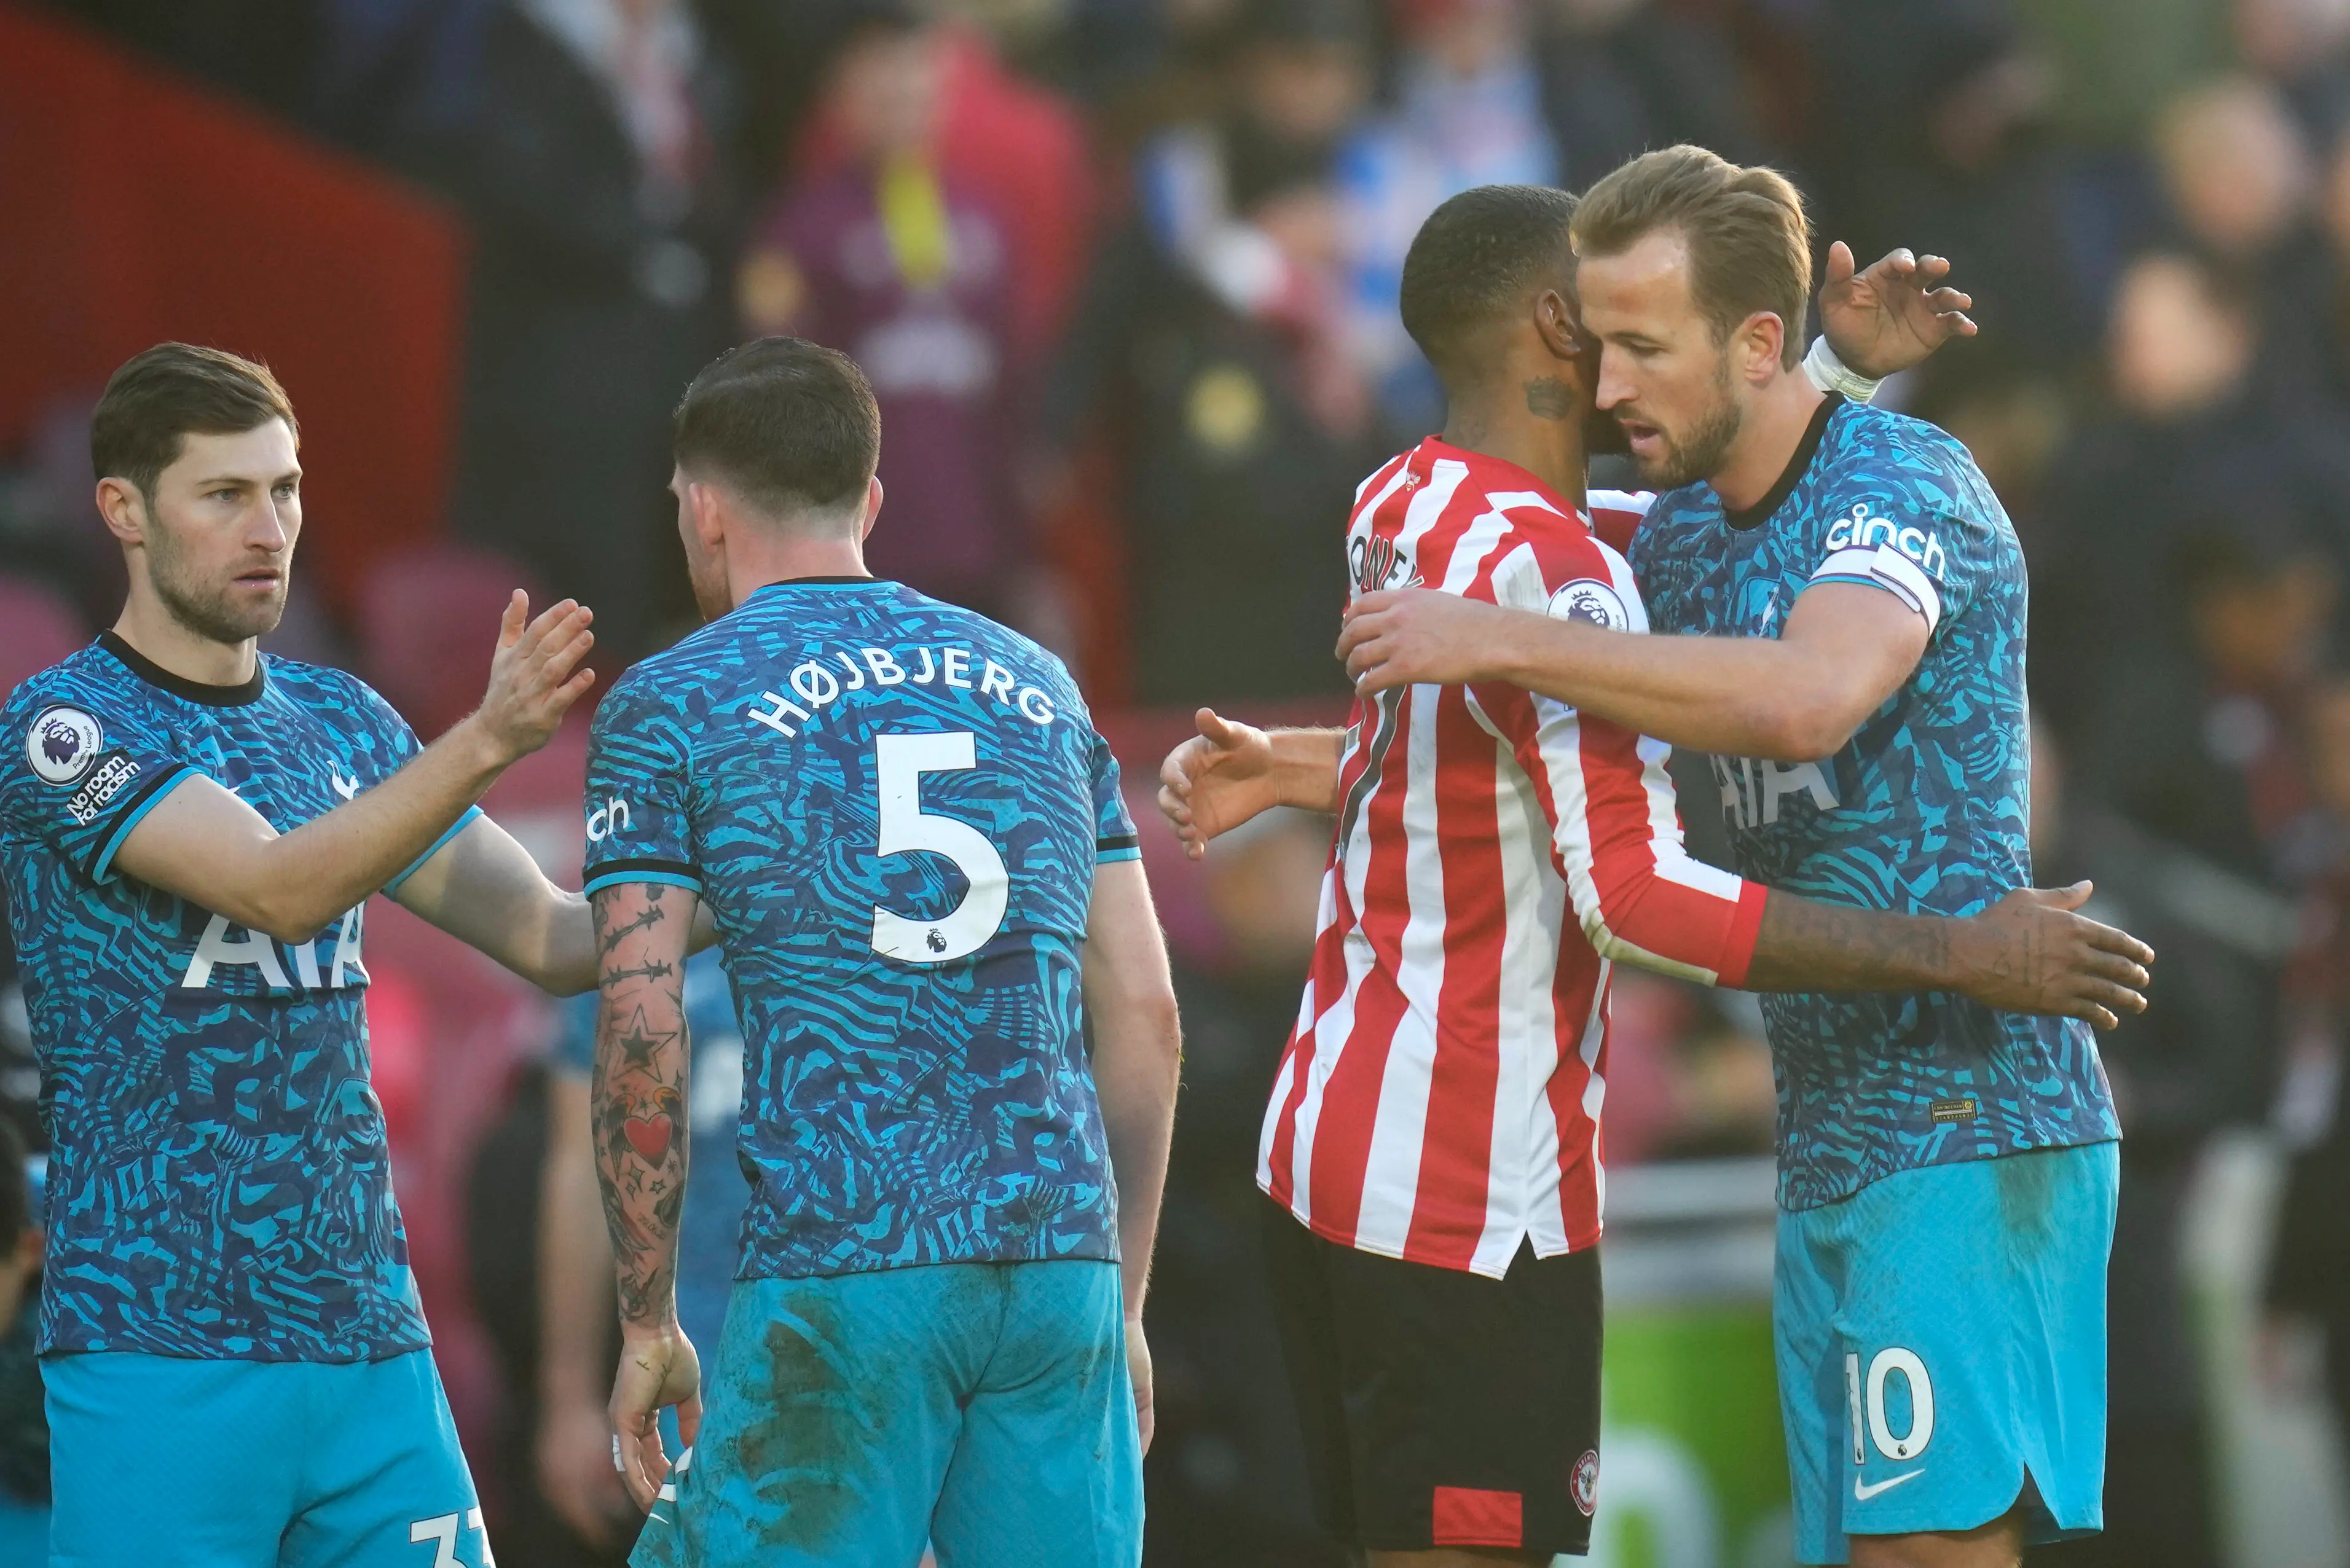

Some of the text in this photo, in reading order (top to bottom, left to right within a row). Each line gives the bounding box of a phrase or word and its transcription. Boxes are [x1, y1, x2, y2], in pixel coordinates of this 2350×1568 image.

[1346, 534, 1425, 591] ONEY
[1826, 503, 1946, 581] cinch
[747, 646, 1056, 739] HØJBJERG
[84, 725, 93, 749] League
[66, 756, 125, 816] No room
[93, 761, 141, 807] racism
[871, 731, 1010, 963] 5
[1845, 1346, 1935, 1465] 10
